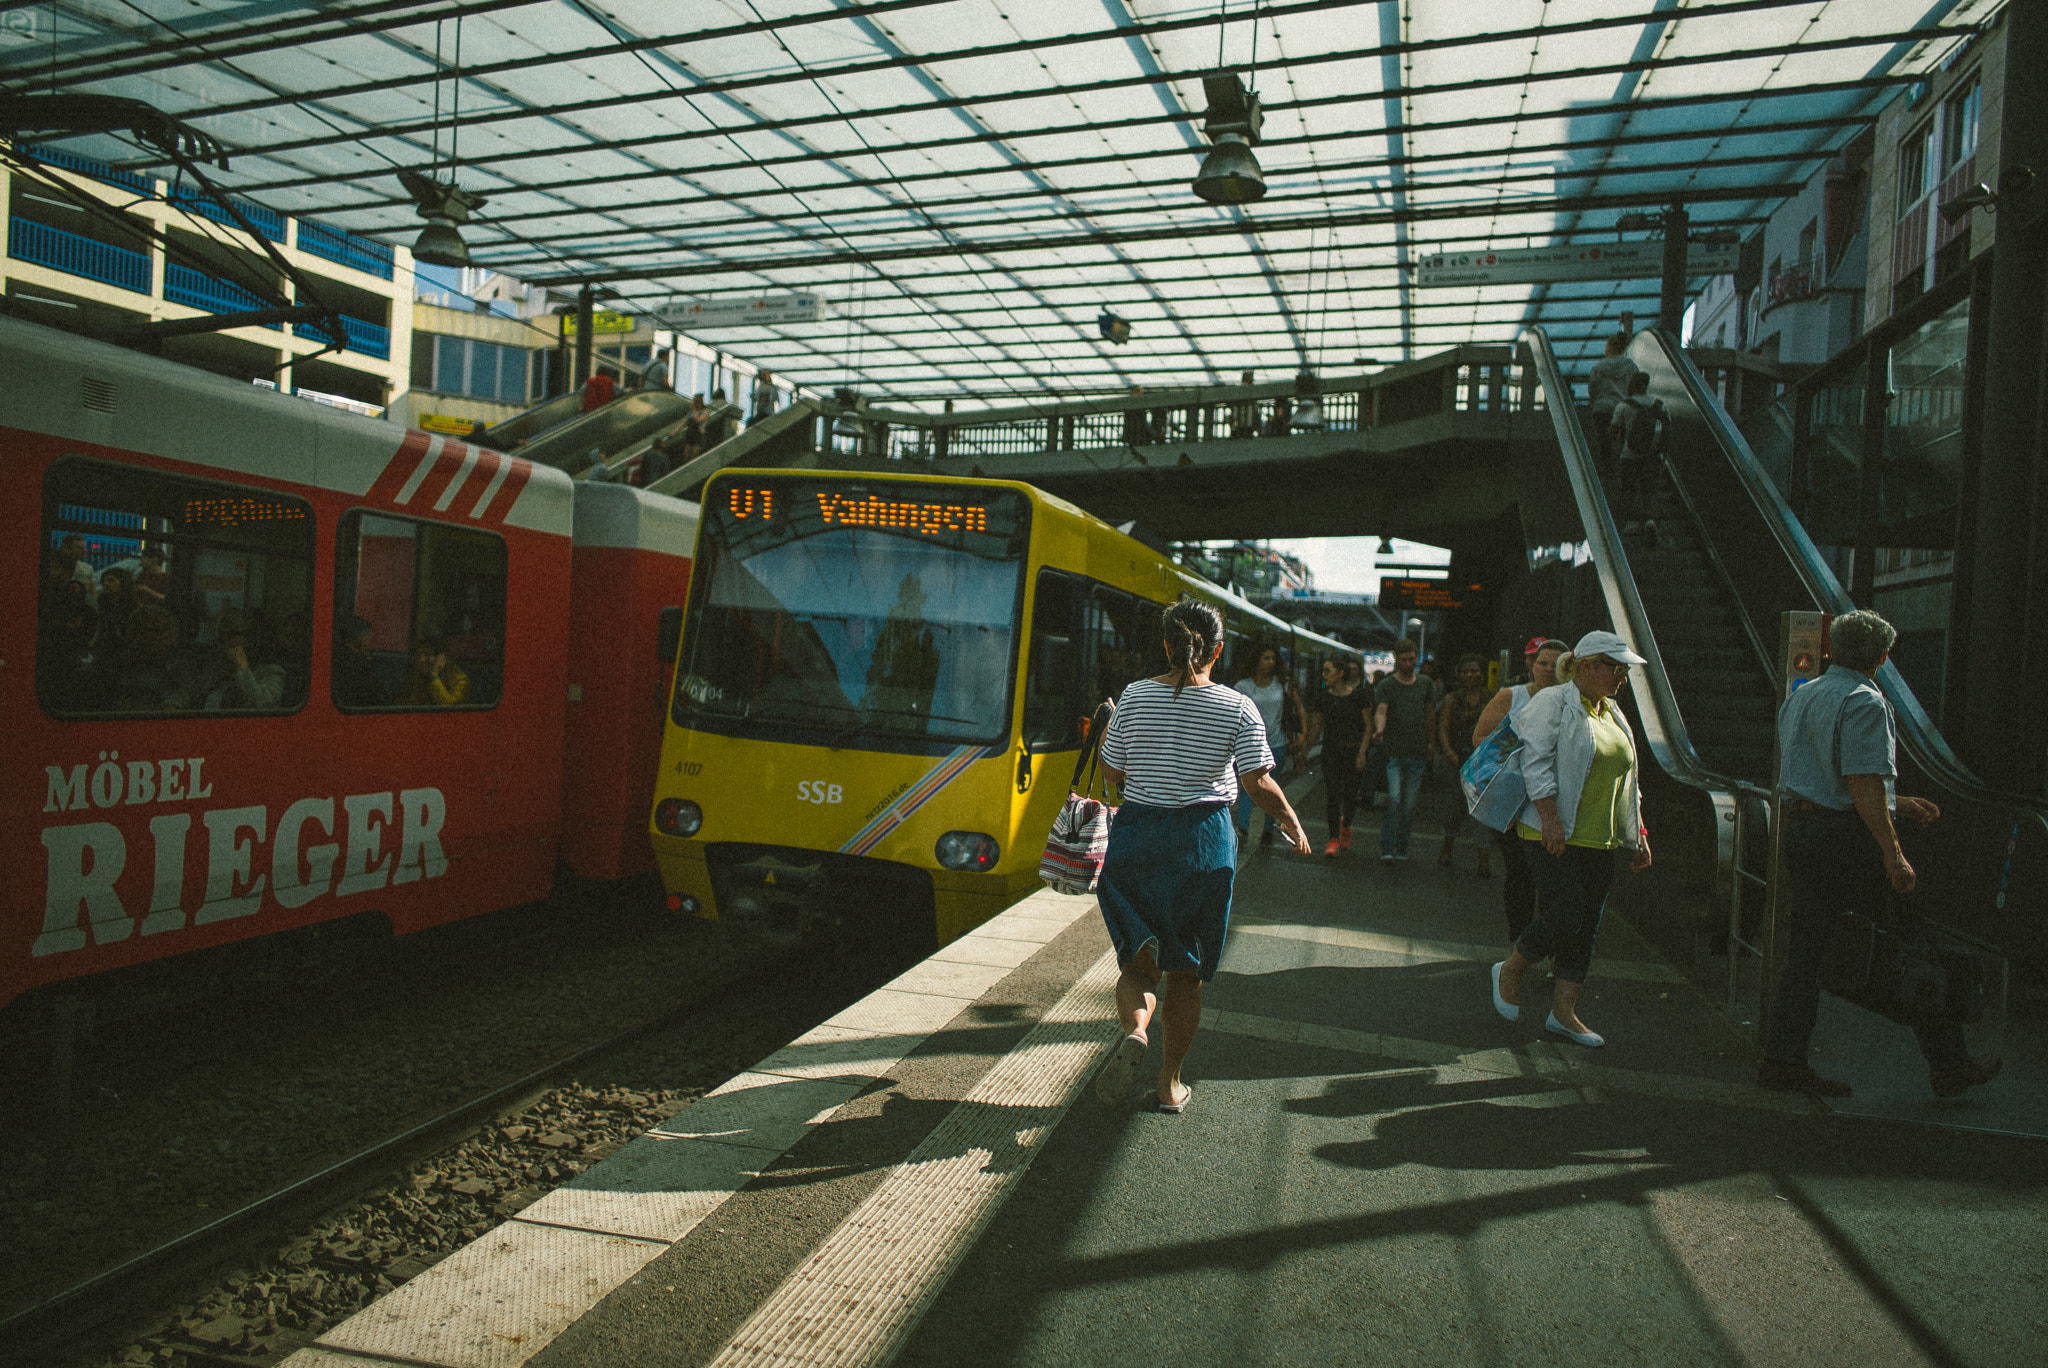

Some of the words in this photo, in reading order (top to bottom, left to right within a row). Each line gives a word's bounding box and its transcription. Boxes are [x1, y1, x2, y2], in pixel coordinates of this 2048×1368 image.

[730, 488, 772, 519] U1
[817, 493, 986, 534] Vaihingen
[43, 751, 212, 813] MÖBEL
[674, 761, 703, 776] 4107
[797, 780, 843, 804] SSB
[865, 782, 909, 821] netz2016.de
[32, 786, 449, 957] RIEGER
